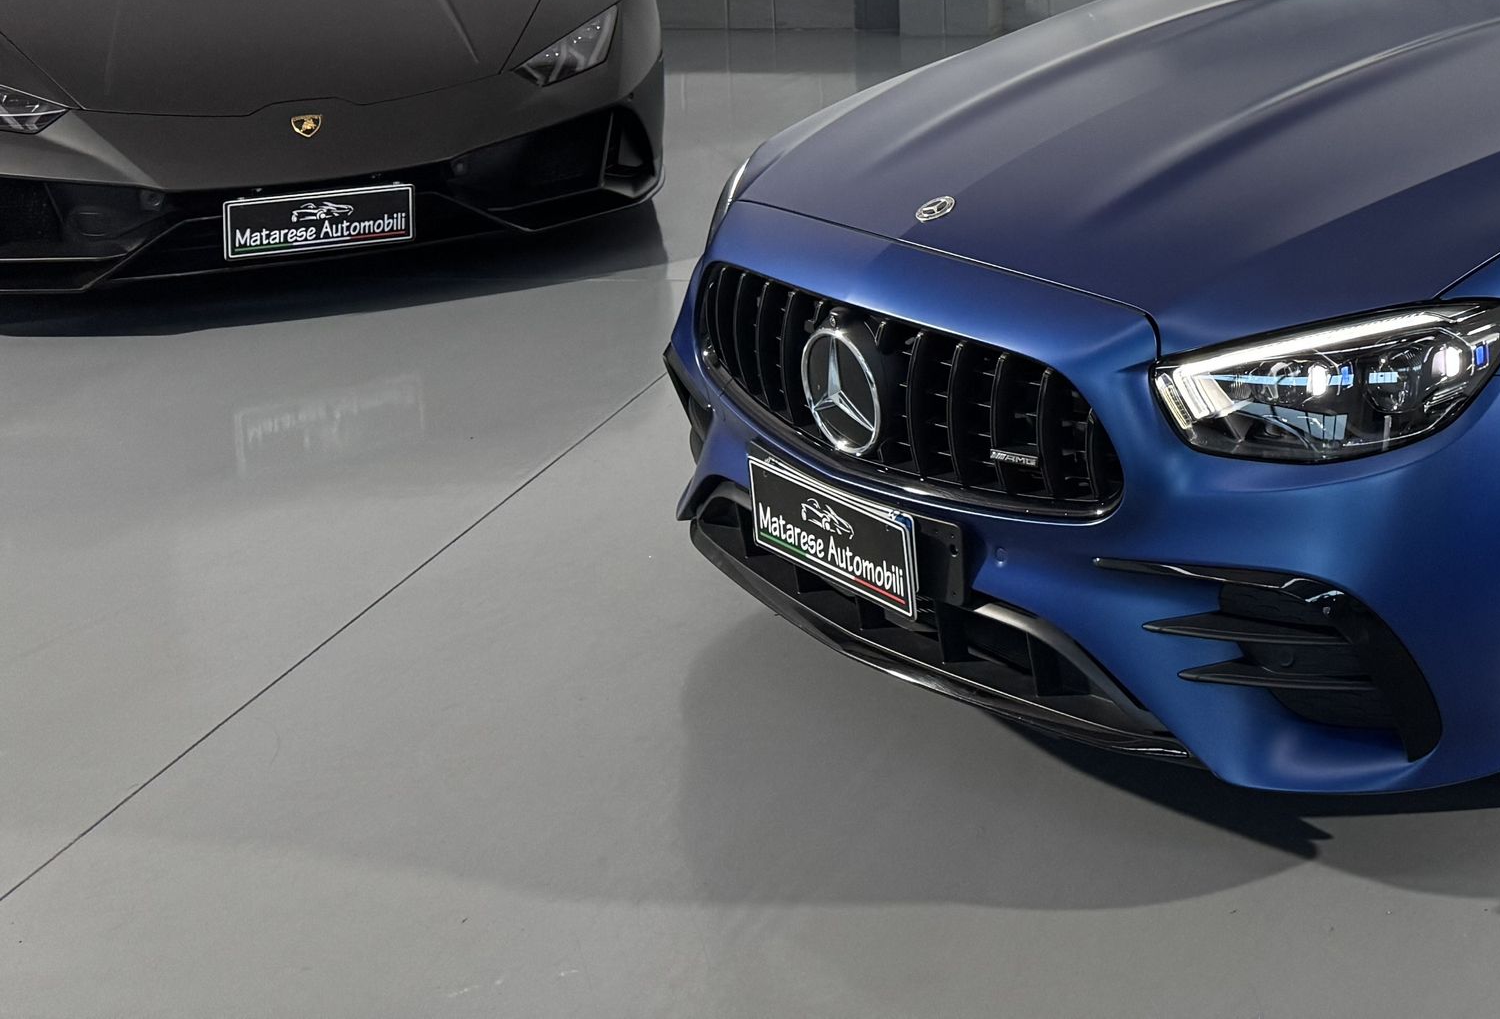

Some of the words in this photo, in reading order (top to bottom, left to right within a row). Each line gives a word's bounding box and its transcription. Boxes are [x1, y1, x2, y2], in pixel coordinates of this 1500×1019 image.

[234, 227, 317, 248] Matarese
[319, 212, 406, 239] Automobili
[757, 501, 825, 558] Matarese
[827, 535, 905, 597] Automobili
